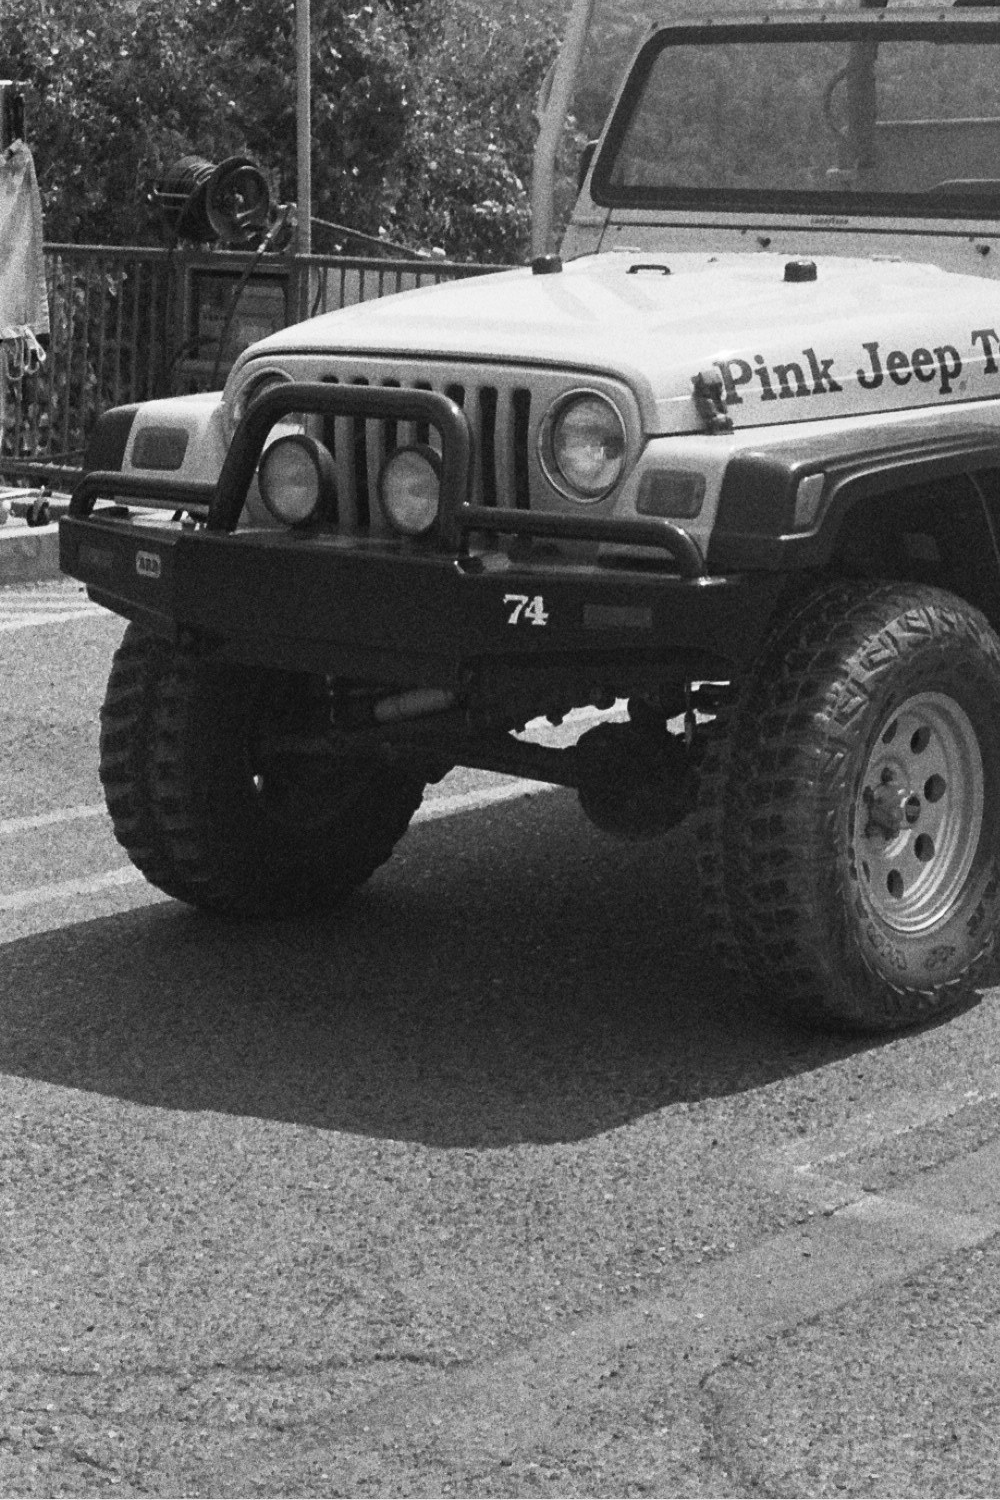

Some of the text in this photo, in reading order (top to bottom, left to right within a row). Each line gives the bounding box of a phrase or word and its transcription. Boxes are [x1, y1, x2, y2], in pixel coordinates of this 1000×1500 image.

[713, 347, 843, 405] Pink
[856, 342, 963, 396] Jeep
[502, 594, 549, 626] 74
